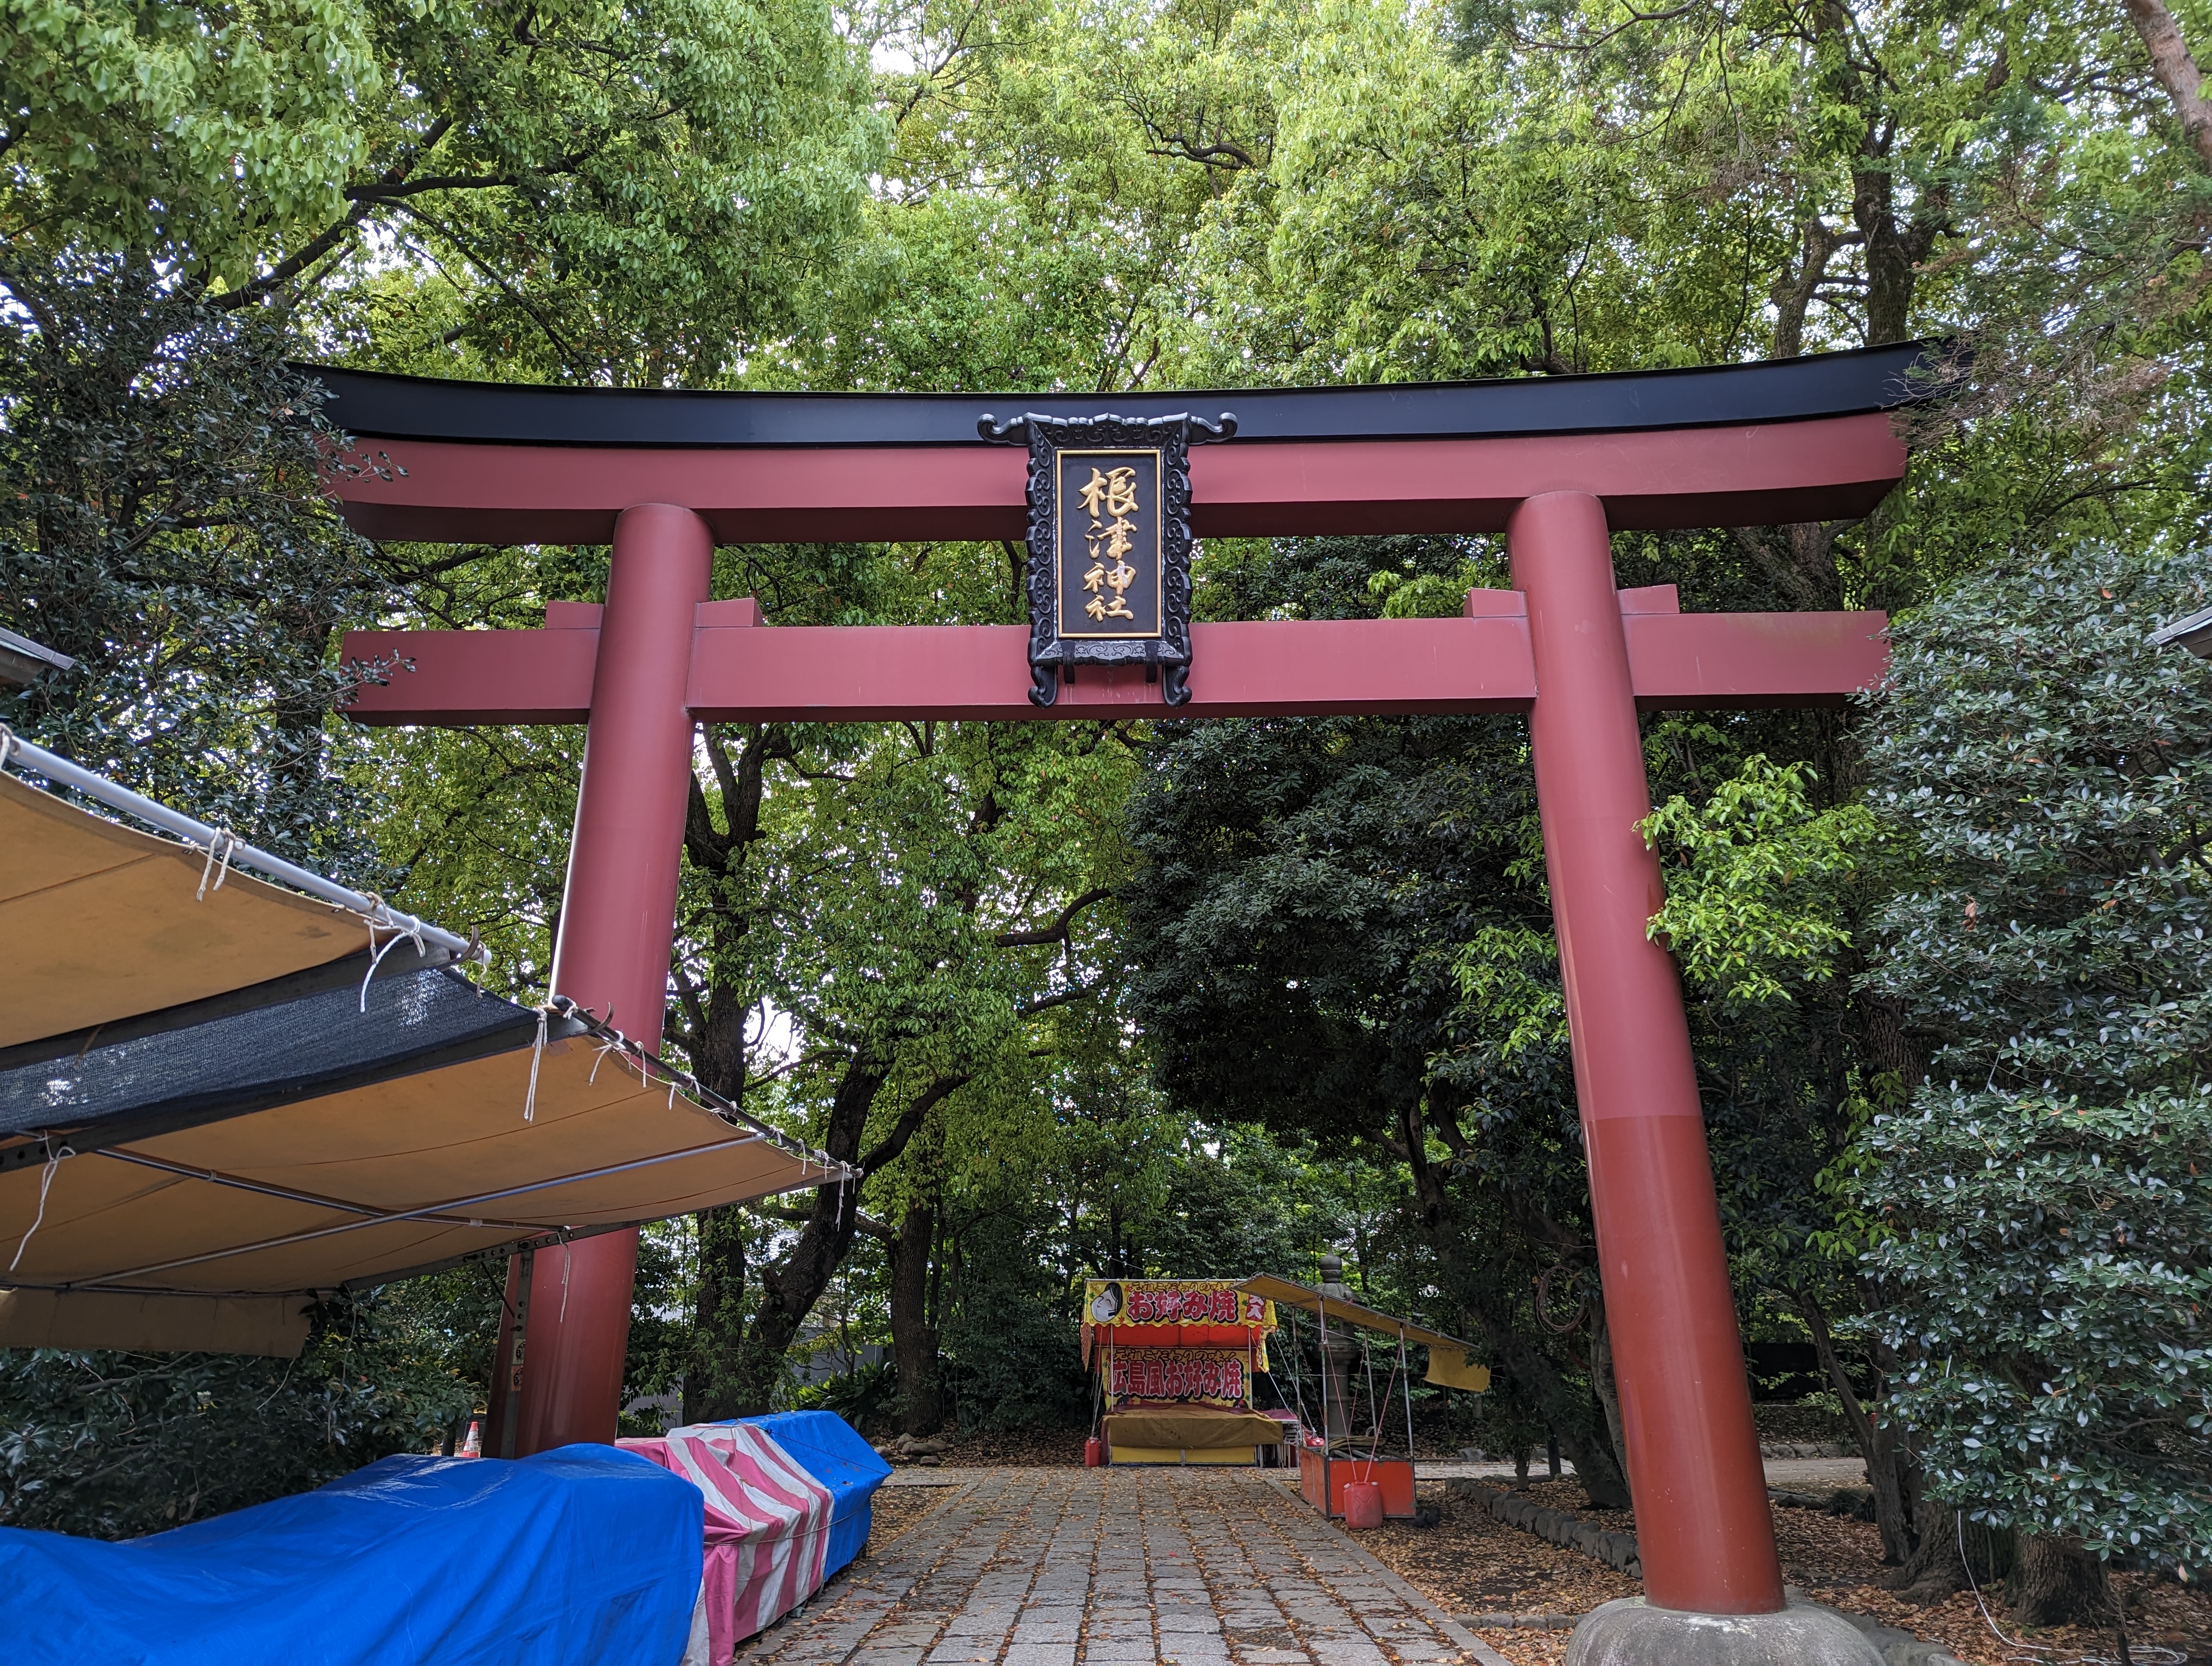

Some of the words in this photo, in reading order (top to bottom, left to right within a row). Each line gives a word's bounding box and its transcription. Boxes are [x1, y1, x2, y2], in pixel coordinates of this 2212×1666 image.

[1077, 467, 1139, 622] 根津神社
[1127, 1290, 1237, 1321] お好み焼
[1114, 1349, 1237, 1362] 元祖こだわりの味!
[1109, 1359, 1242, 1399] 広島風お好み焼
